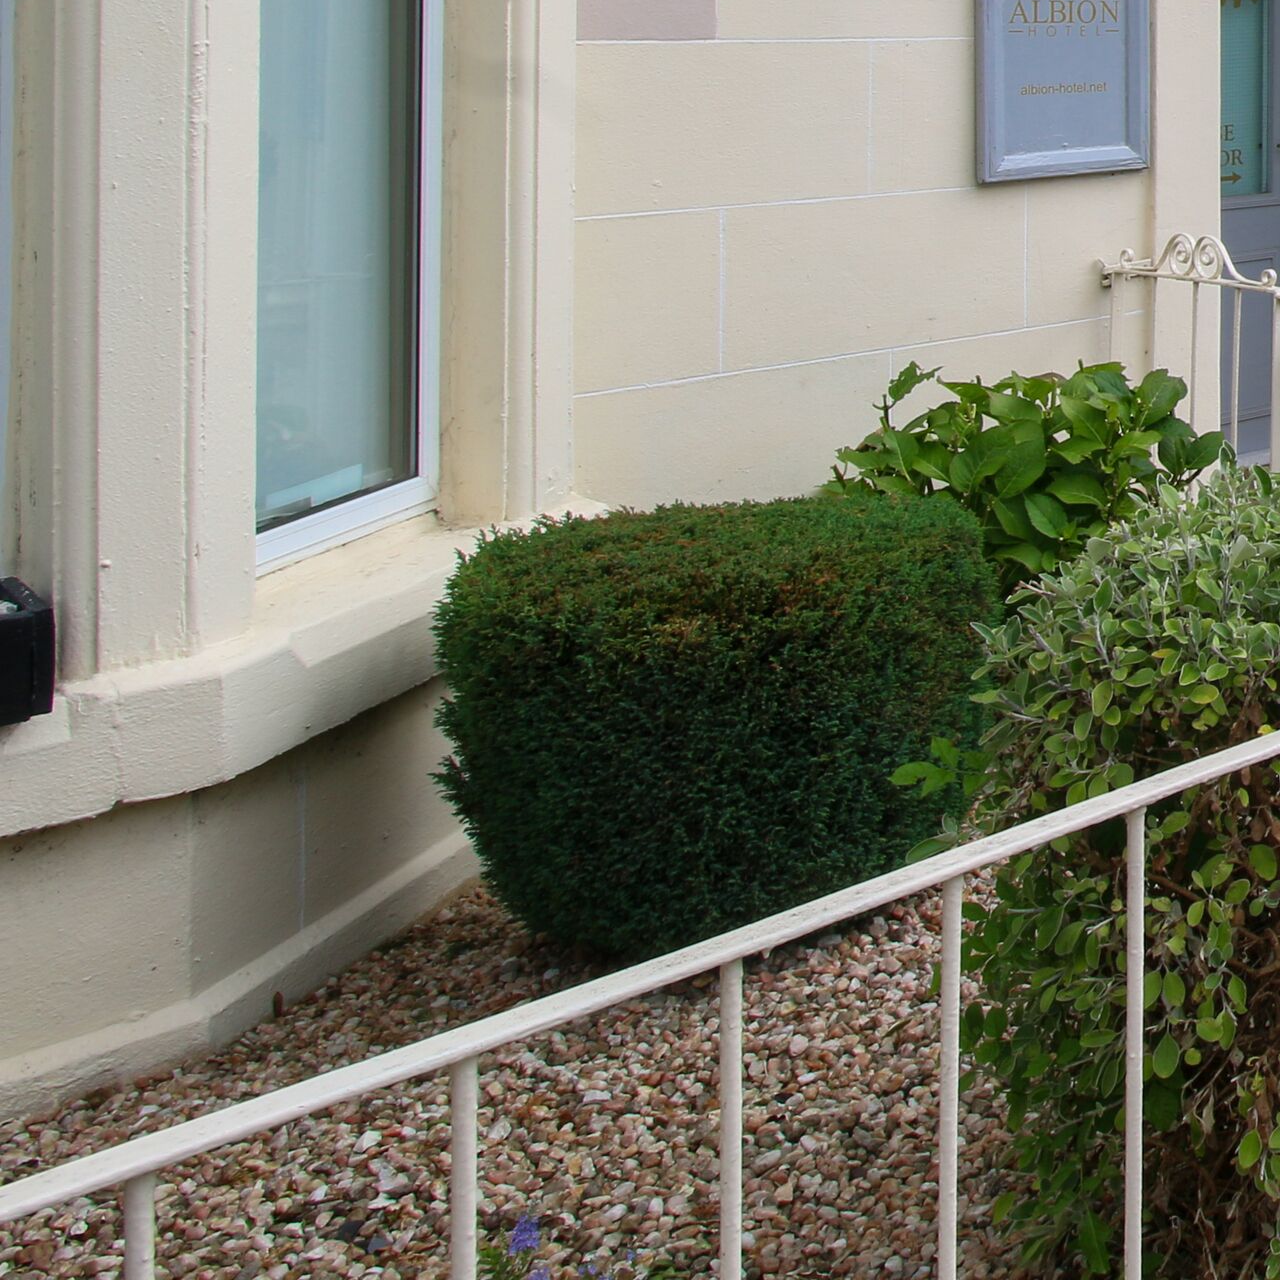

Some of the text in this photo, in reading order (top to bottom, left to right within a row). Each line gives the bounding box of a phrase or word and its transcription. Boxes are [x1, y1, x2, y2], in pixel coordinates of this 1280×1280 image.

[1009, 0, 1120, 25] ALBION
[1028, 25, 1101, 38] HOTEL
[1020, 81, 1107, 97] albion-hotel.net
